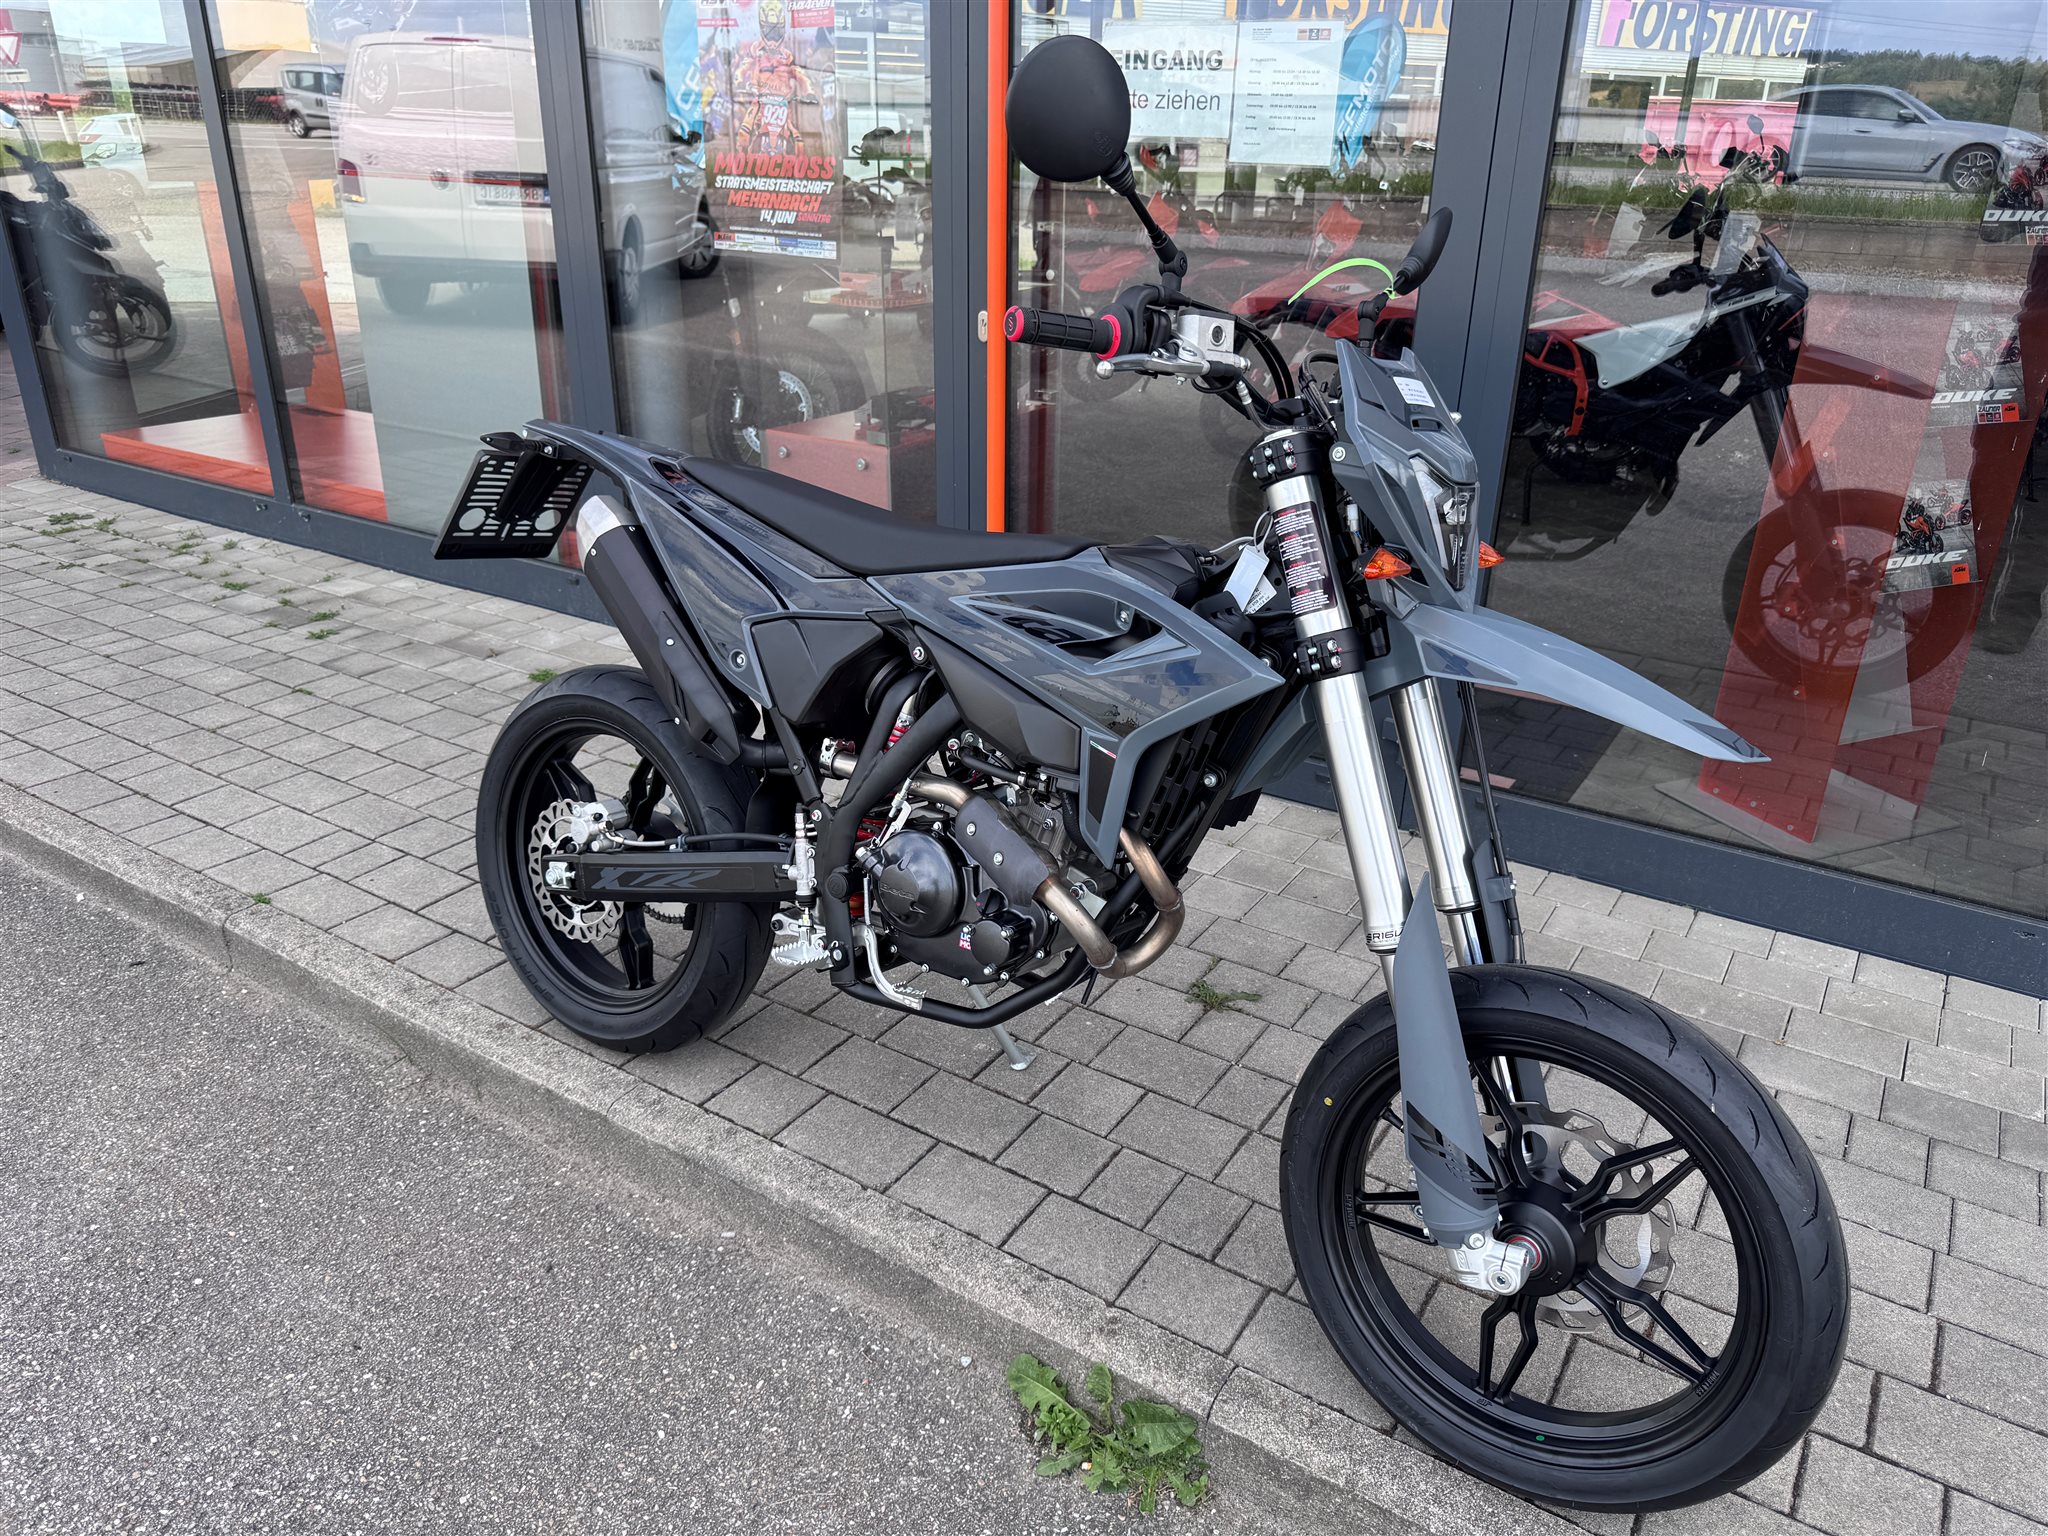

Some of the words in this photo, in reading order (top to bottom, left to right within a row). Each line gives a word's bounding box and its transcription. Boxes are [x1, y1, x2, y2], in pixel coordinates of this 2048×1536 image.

[1111, 50, 1223, 71] EINGANG
[1155, 88, 1220, 111] ziehen
[763, 105, 788, 126] 929
[713, 152, 836, 180] MOTOCROSS
[715, 175, 835, 195] STAATSMEISTERSCHAFT
[727, 189, 822, 213] MEHRNBACH
[1930, 388, 2018, 404] DUKE
[1886, 549, 1968, 570] DUKE
